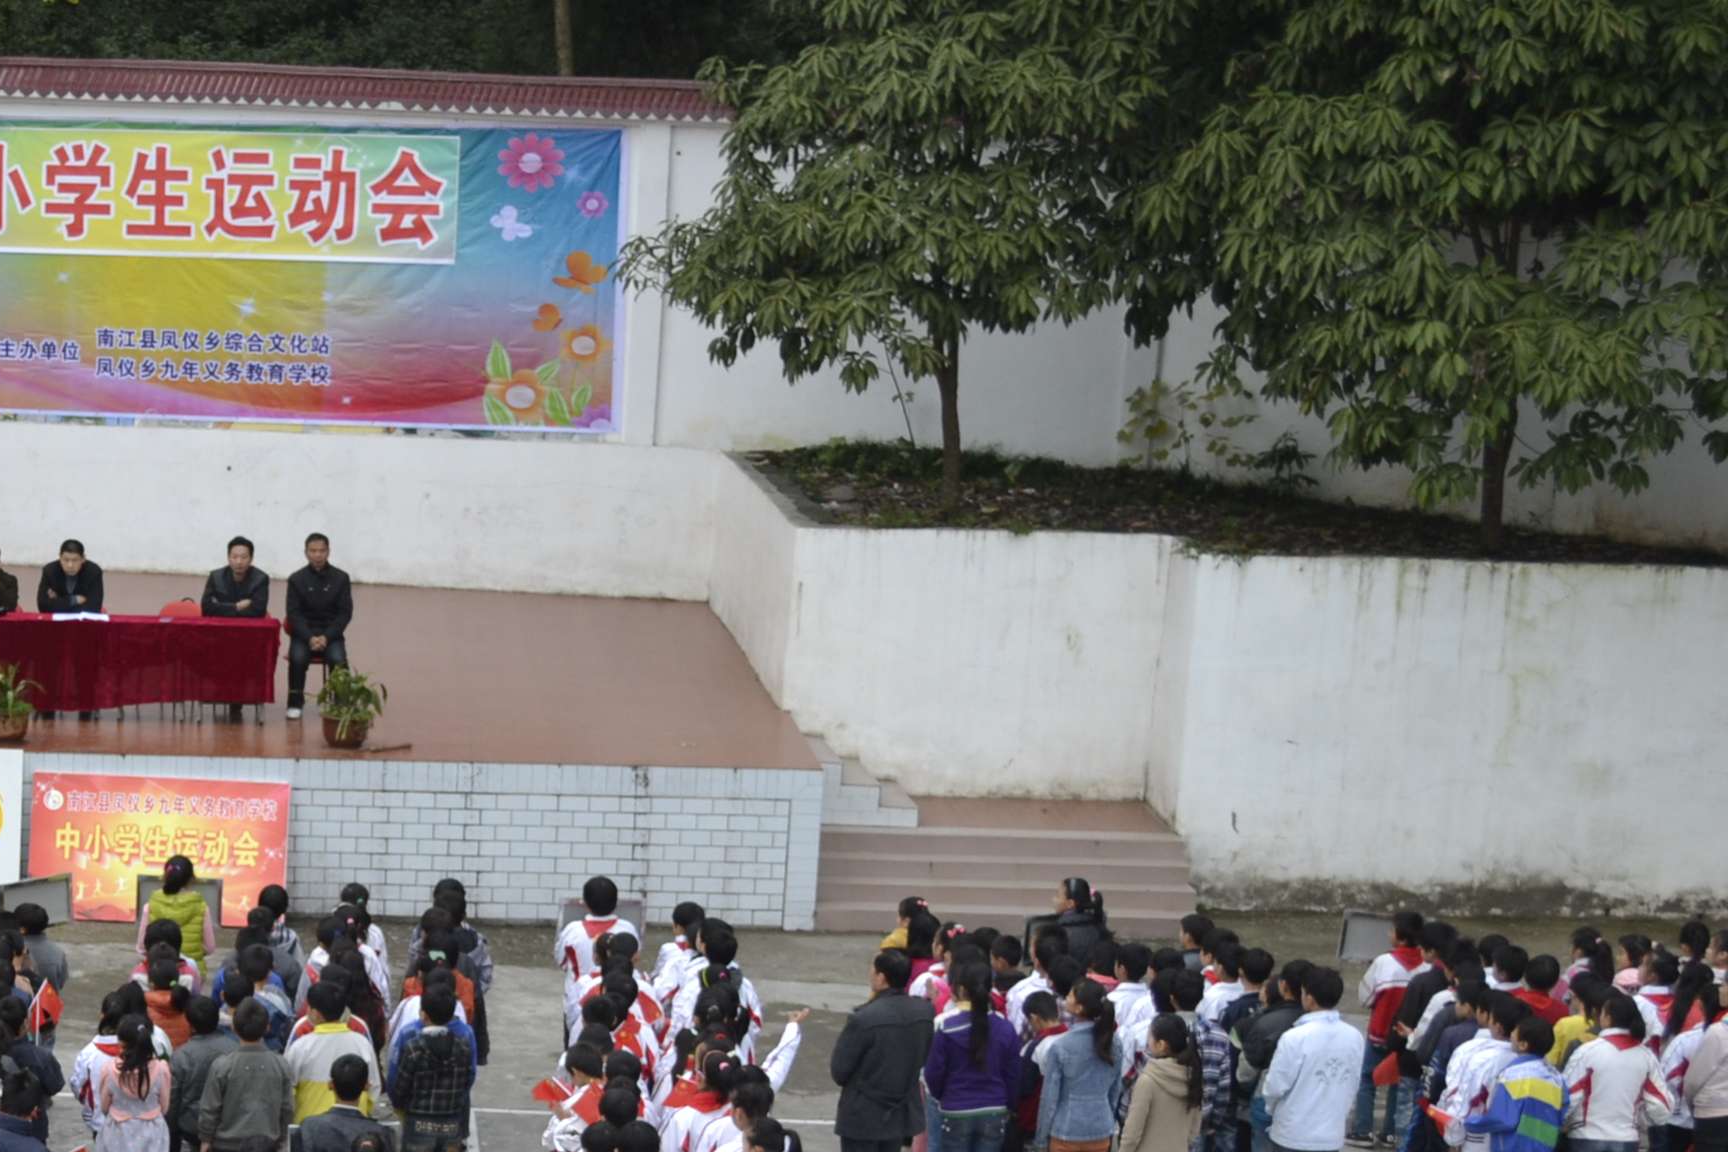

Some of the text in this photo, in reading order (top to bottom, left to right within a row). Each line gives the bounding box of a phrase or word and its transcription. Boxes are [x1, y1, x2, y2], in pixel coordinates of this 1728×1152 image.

[96, 328, 330, 355] 南江县凤仪乡综合文化站
[95, 358, 330, 384] 凤仪乡九年义务教育学校
[66, 789, 278, 822] 南江县凤仪乡九年义务教育学校
[54, 821, 261, 868] 中小学生运动会
